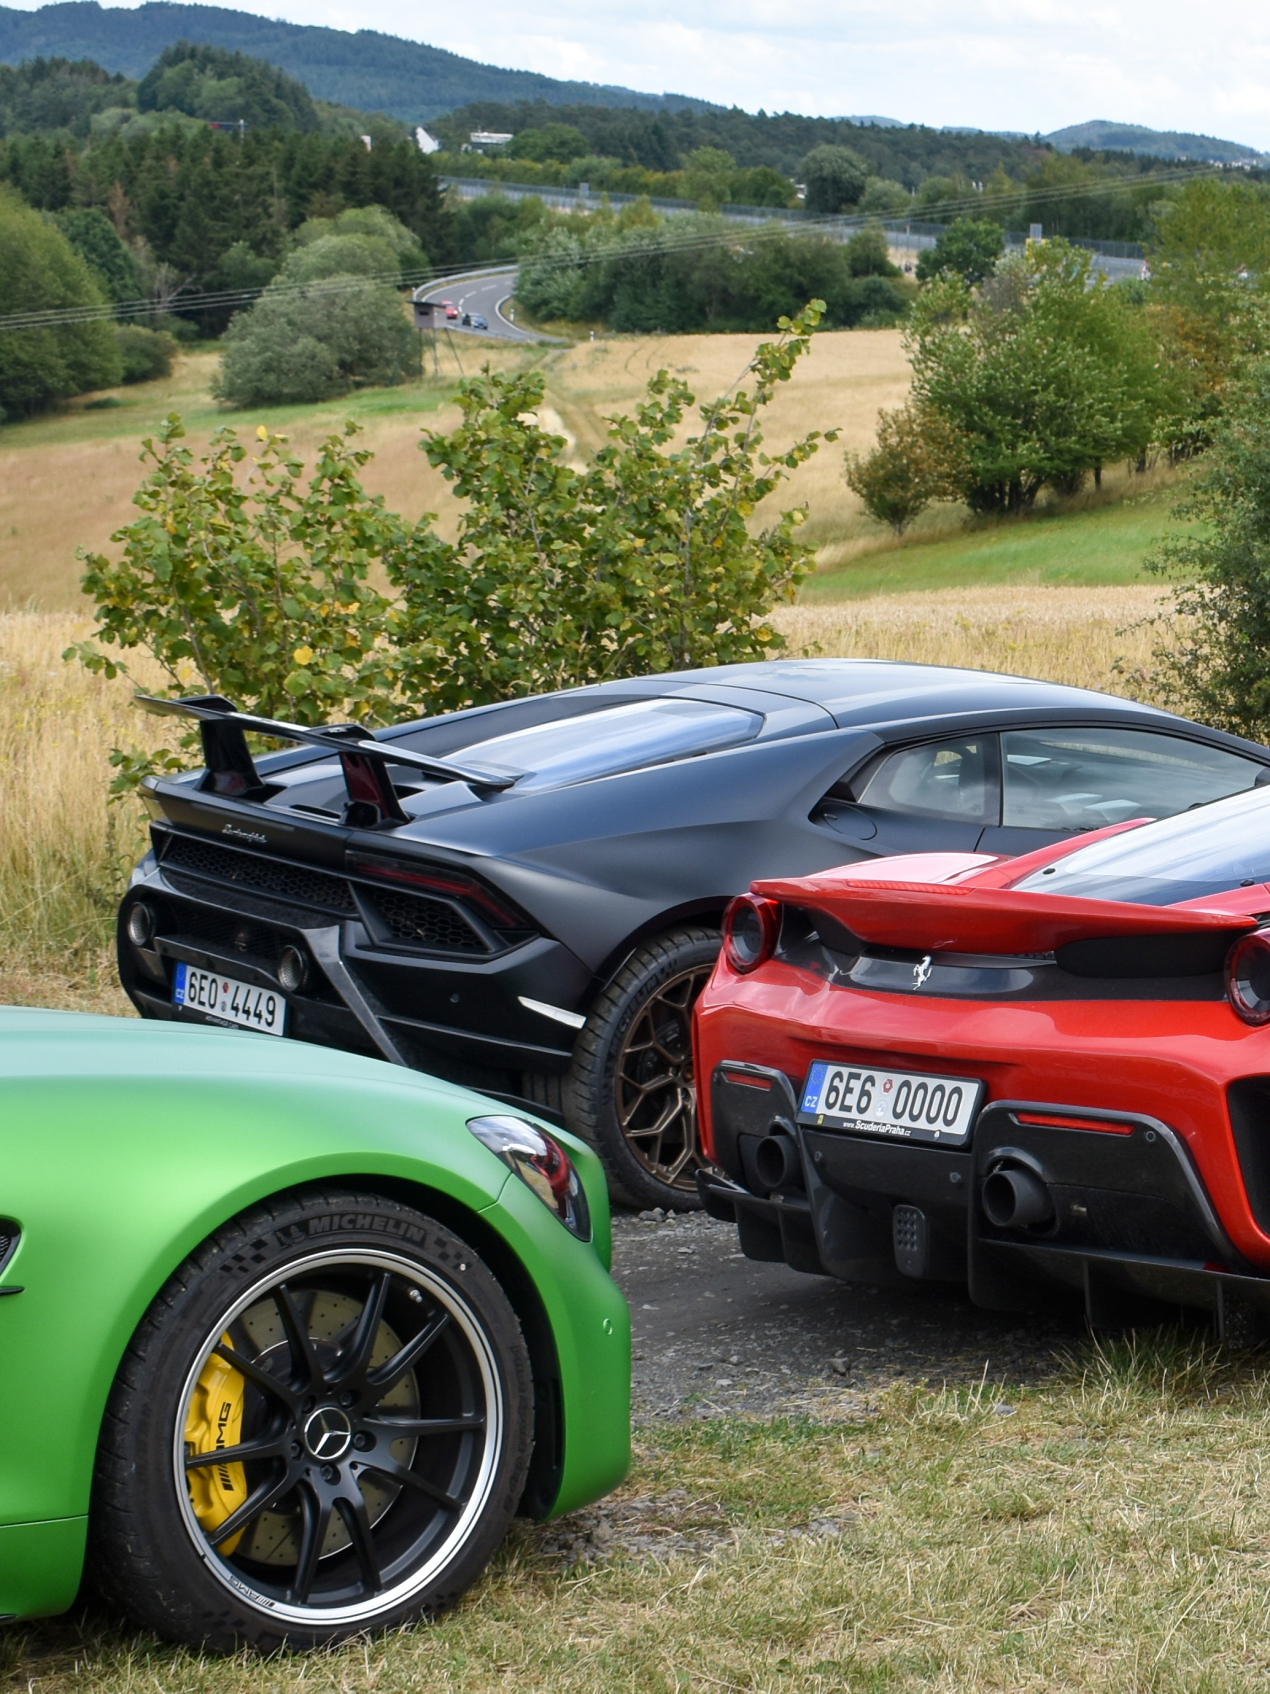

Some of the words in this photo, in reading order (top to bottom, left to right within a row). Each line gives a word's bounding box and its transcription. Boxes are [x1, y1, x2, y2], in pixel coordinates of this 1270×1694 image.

[175, 989, 185, 999] CZ
[230, 985, 277, 1028] 4449
[804, 1095, 818, 1108] CZ
[825, 1070, 876, 1114] 6E6
[892, 1079, 964, 1127] 0000
[843, 1120, 912, 1137] www.ScuderiaPraha.cz
[308, 1213, 427, 1245] MICHELIN
